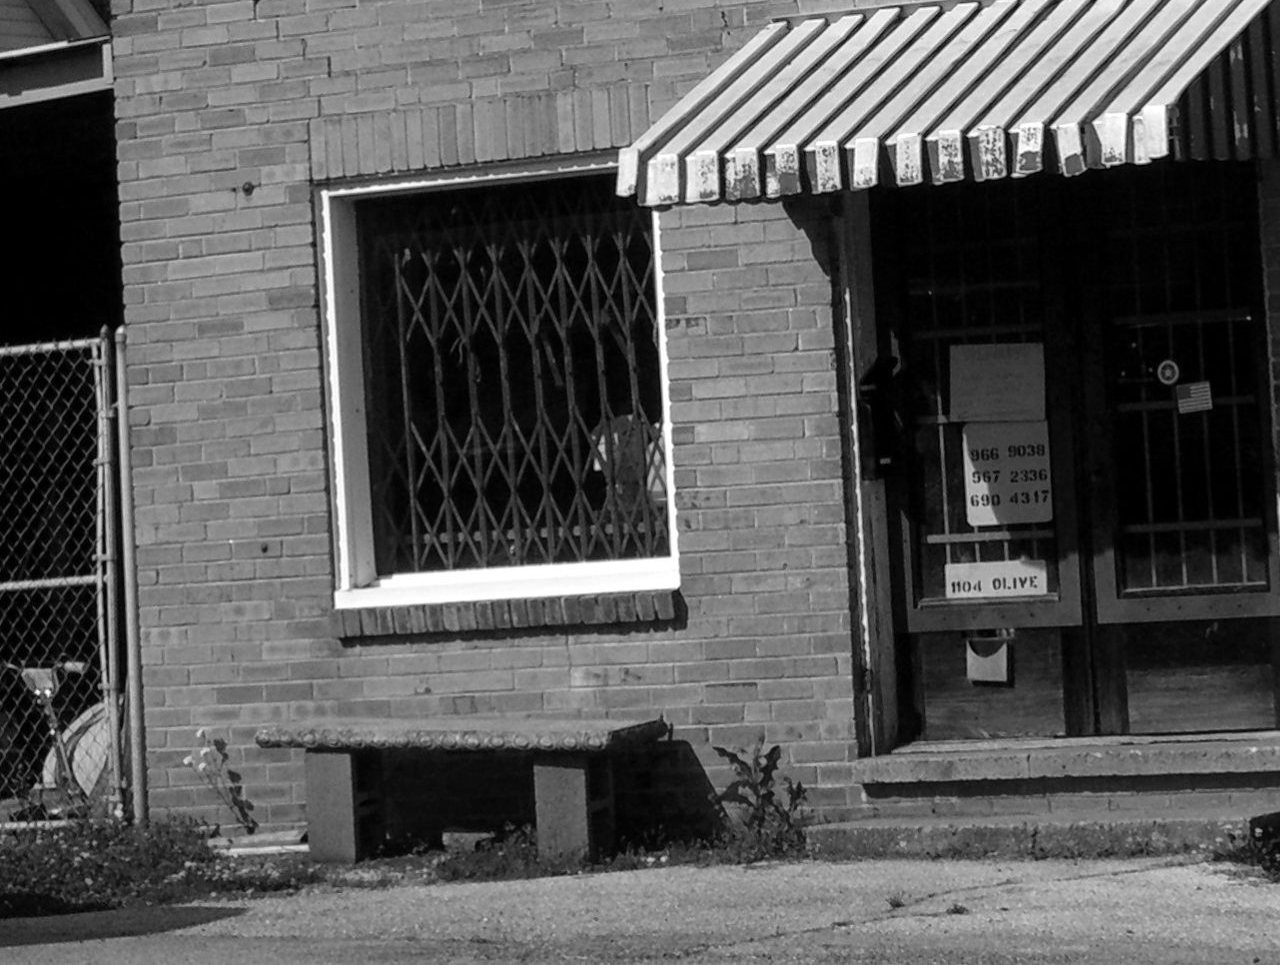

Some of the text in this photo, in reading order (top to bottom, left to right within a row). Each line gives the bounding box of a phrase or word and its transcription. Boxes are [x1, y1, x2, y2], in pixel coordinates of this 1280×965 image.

[970, 444, 1045, 461] 966 9038
[972, 468, 1047, 484] 967 2336
[970, 490, 1049, 507] 690 4317
[951, 575, 1038, 593] 1104 OLIVE
